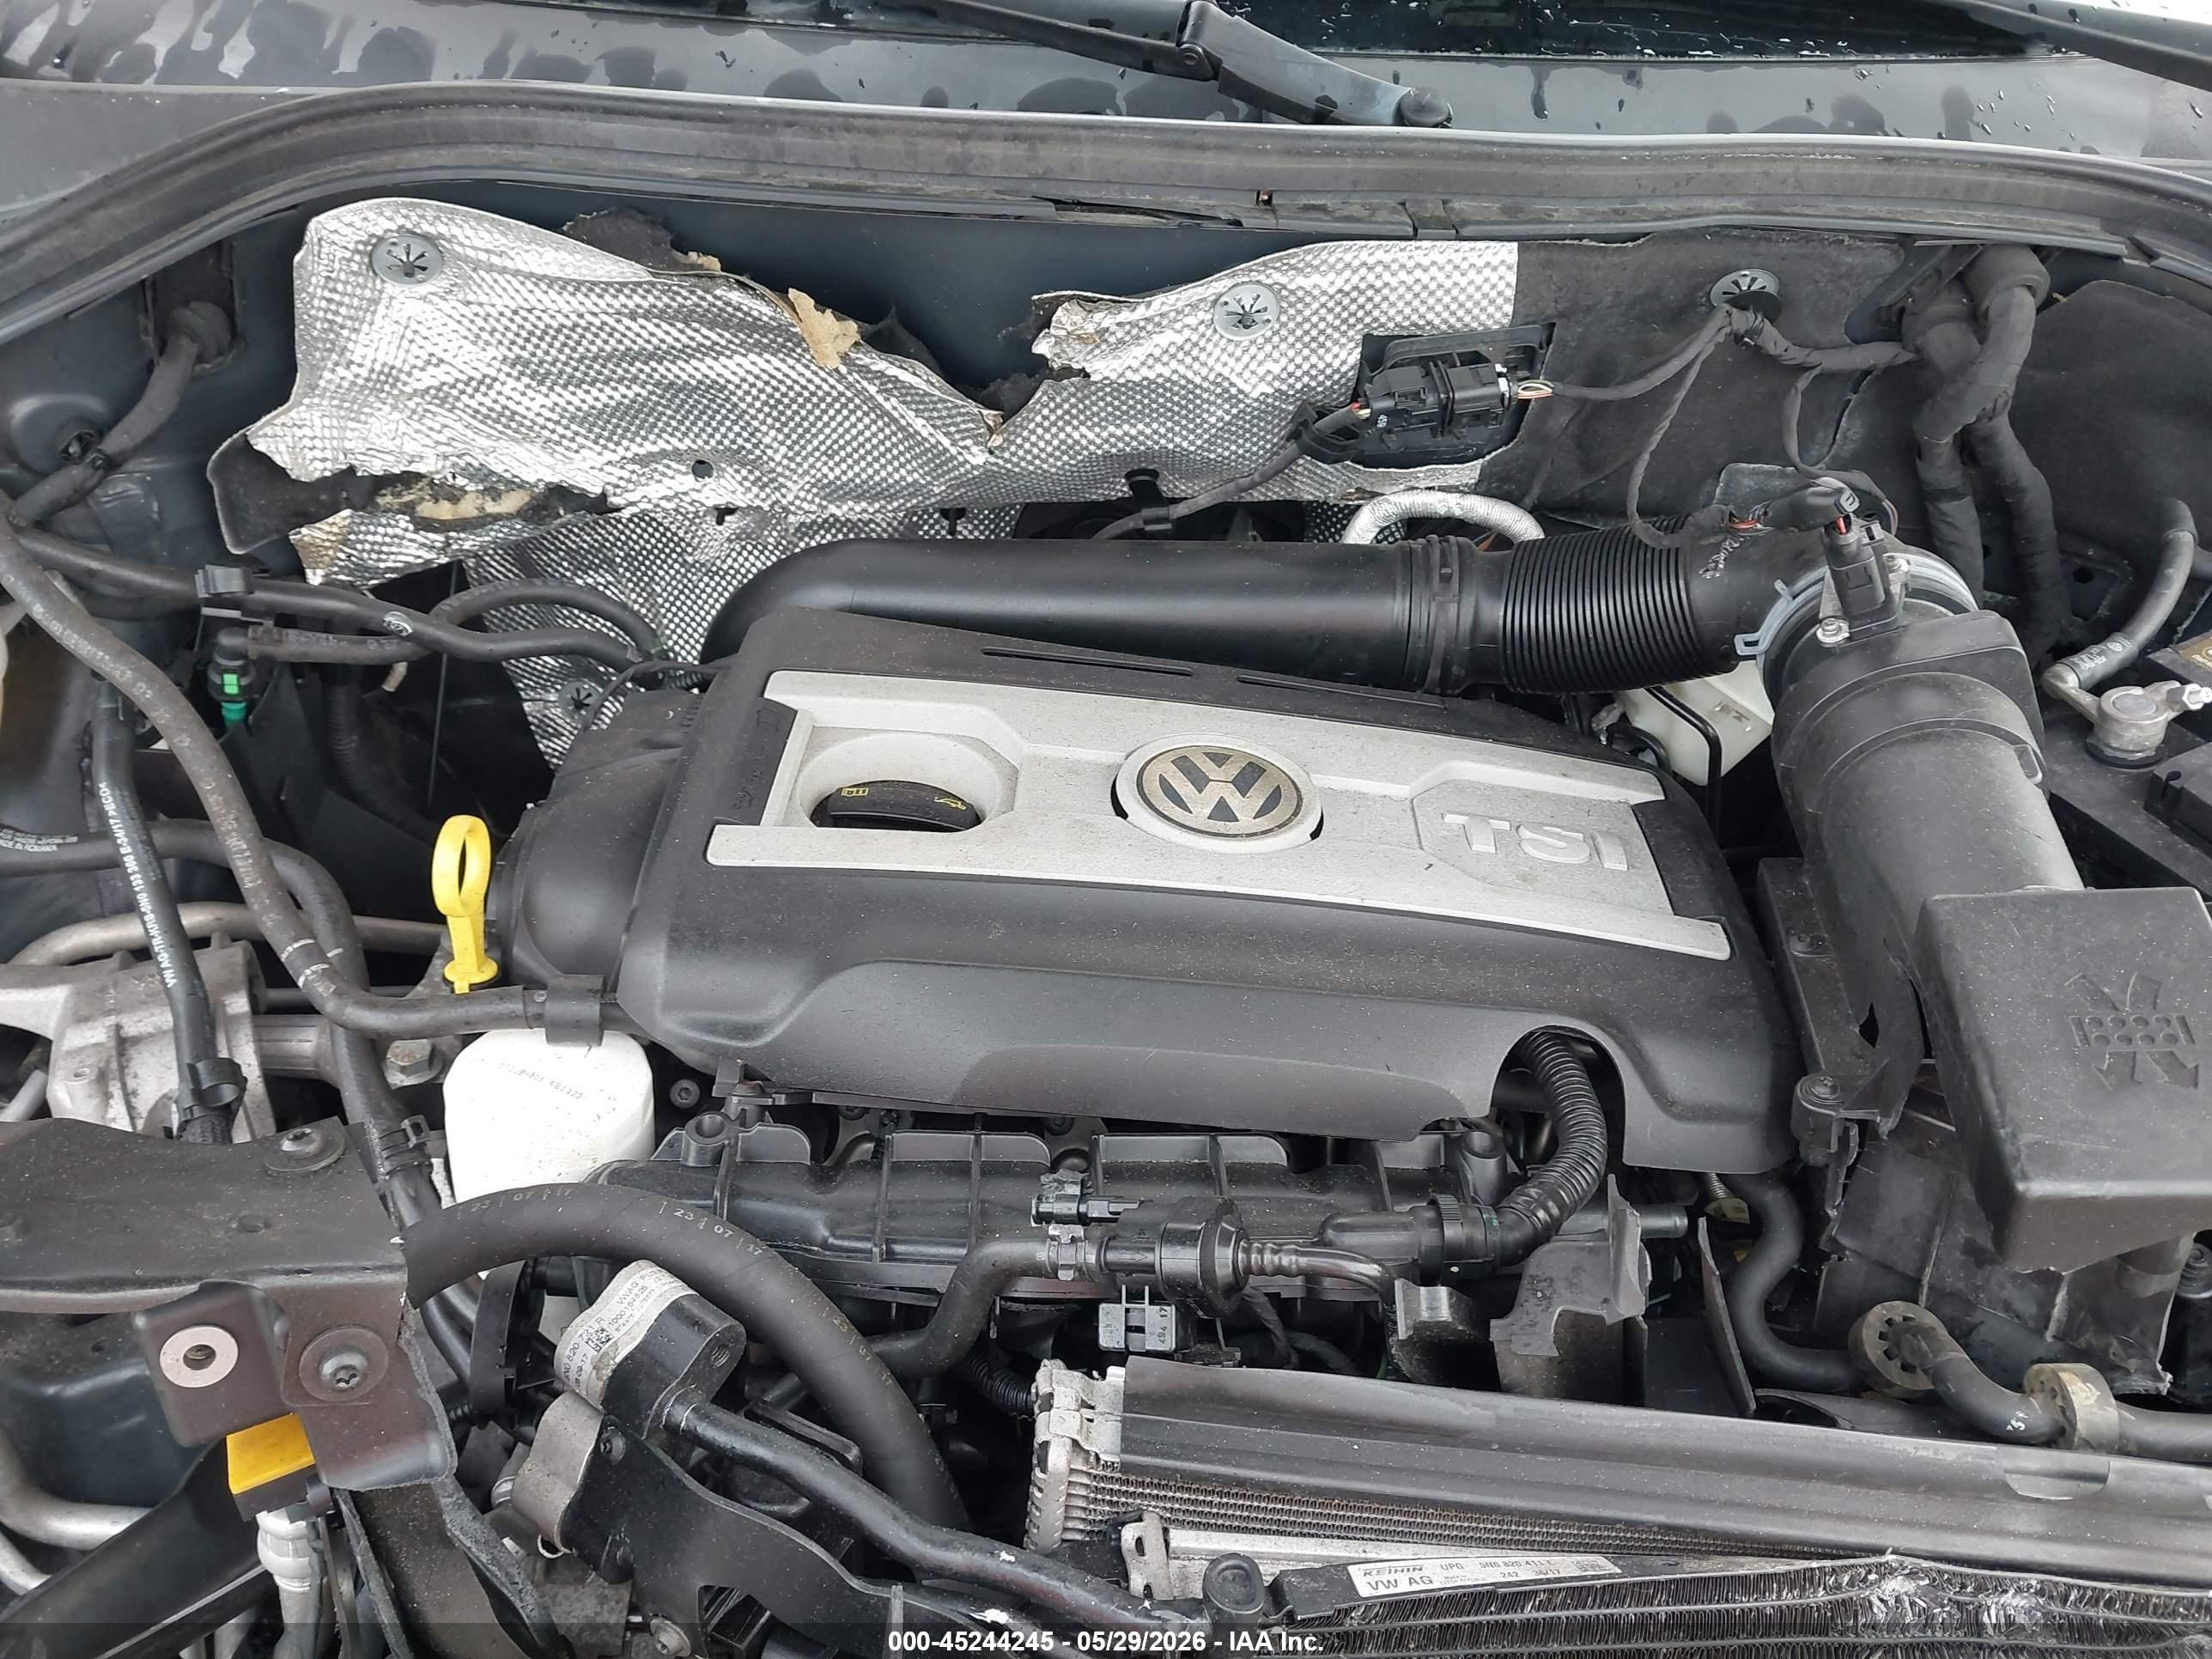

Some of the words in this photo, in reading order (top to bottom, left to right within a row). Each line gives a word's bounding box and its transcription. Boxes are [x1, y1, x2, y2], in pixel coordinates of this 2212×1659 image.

[1137, 745, 1303, 837] VW
[1442, 811, 1630, 872] TSI
[673, 1207, 694, 1222] 23
[714, 1224, 734, 1238] 07
[1362, 1565, 1424, 1577] KEIHIN
[1367, 1577, 1399, 1591] VW
[1407, 1575, 1434, 1587] AG
